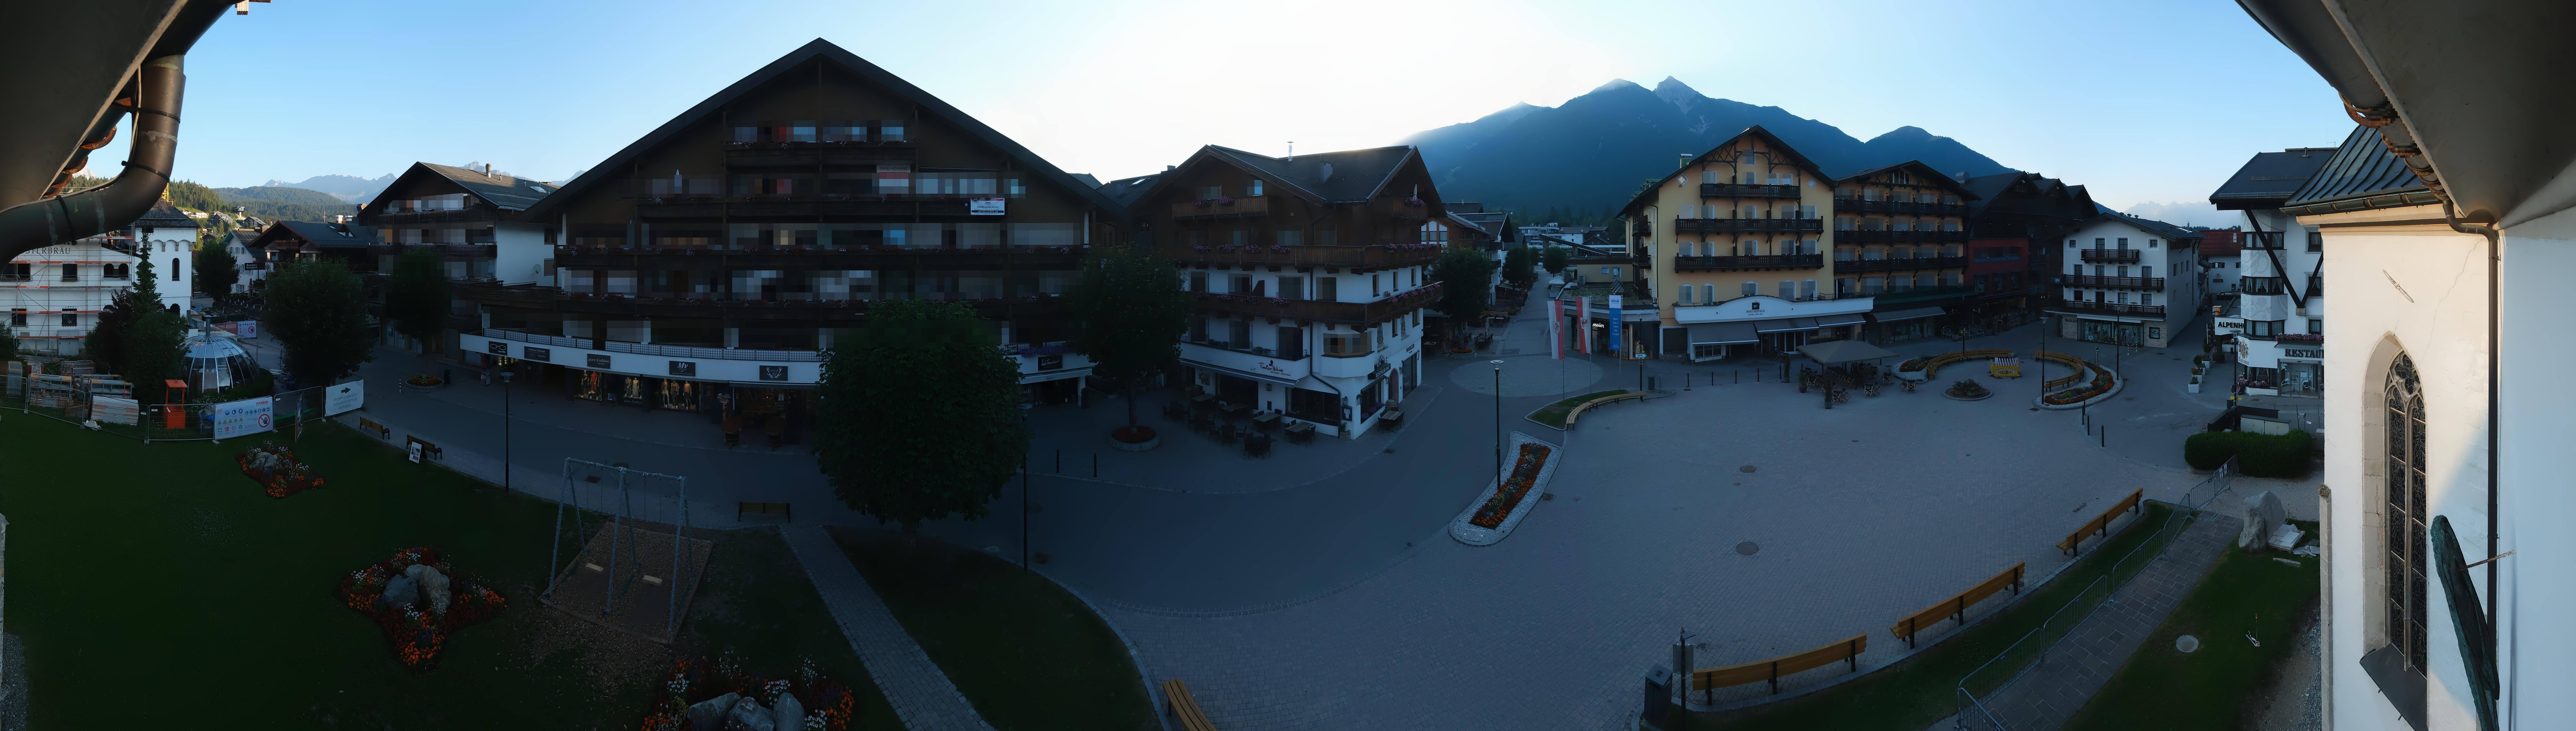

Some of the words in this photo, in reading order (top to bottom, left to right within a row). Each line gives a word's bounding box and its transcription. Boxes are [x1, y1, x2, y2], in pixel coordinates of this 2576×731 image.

[1406, 344, 1414, 352] SAILER
[1376, 365, 1390, 378] RESTAURANT
[333, 397, 357, 406] KONGRESSZENTRUM
